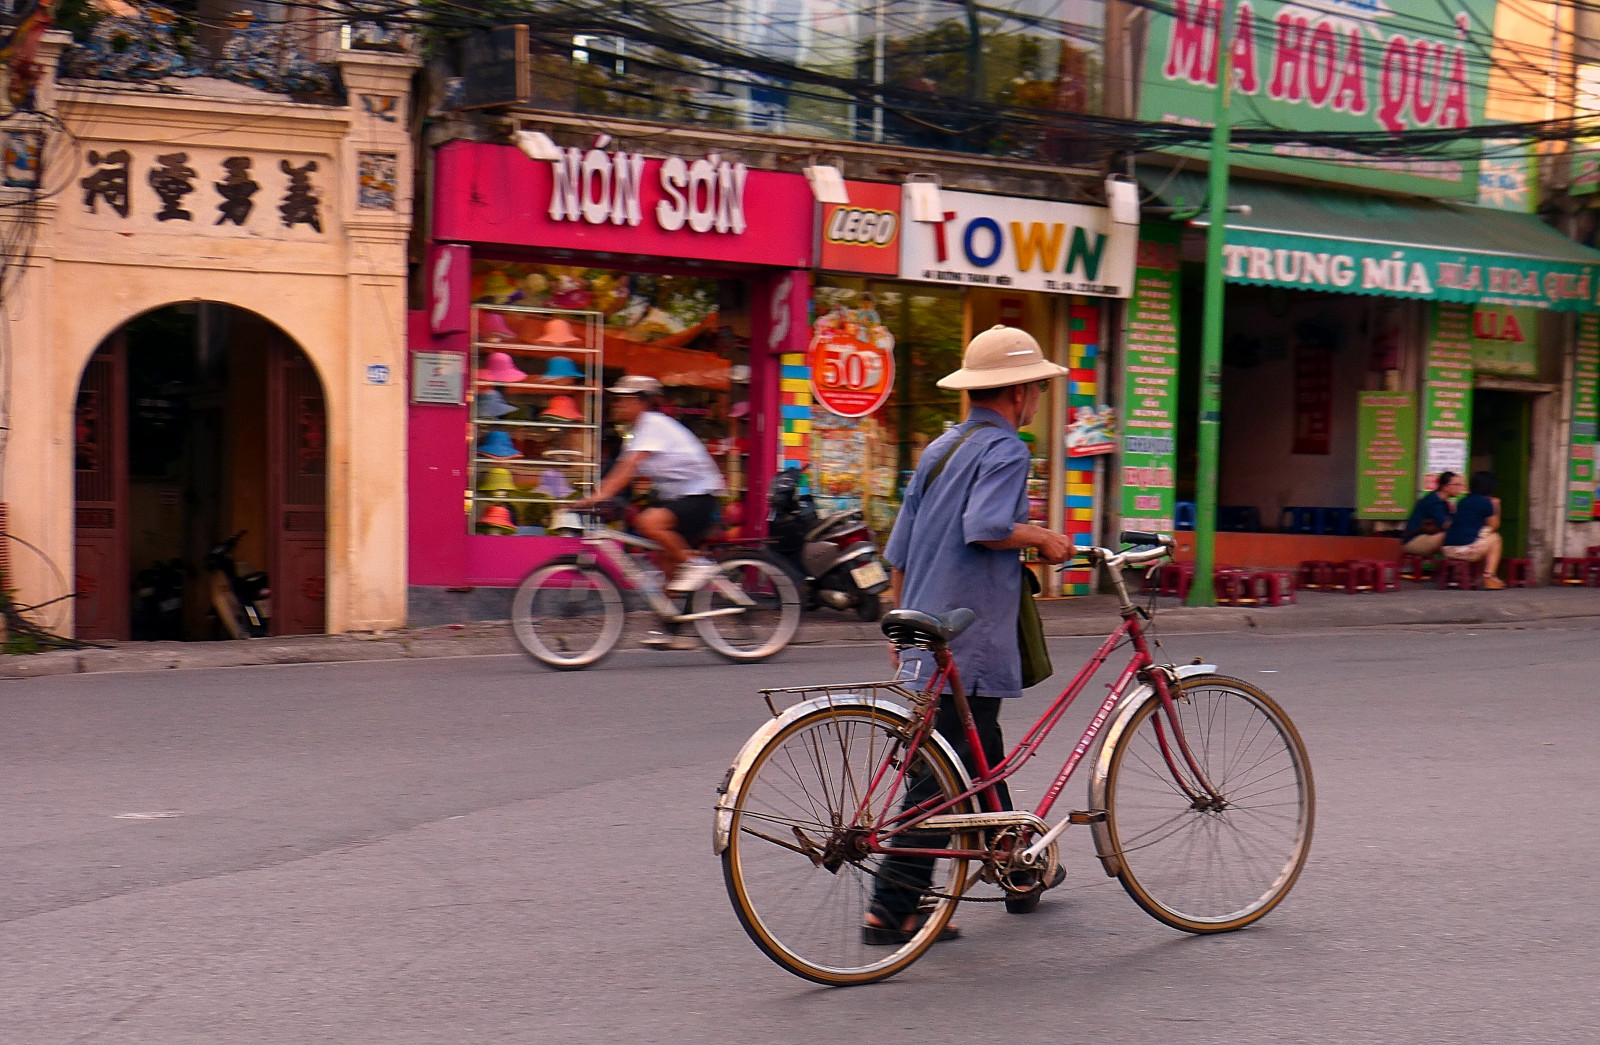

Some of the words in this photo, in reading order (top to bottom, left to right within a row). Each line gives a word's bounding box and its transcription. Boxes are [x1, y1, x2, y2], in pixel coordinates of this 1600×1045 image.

[1268, 13, 1368, 115] HOA
[548, 133, 646, 227] NÓN
[830, 207, 896, 246] LEGO
[930, 210, 1108, 281] TOWN
[1223, 244, 1357, 288] TRUNG
[1360, 250, 1433, 295] MÍA
